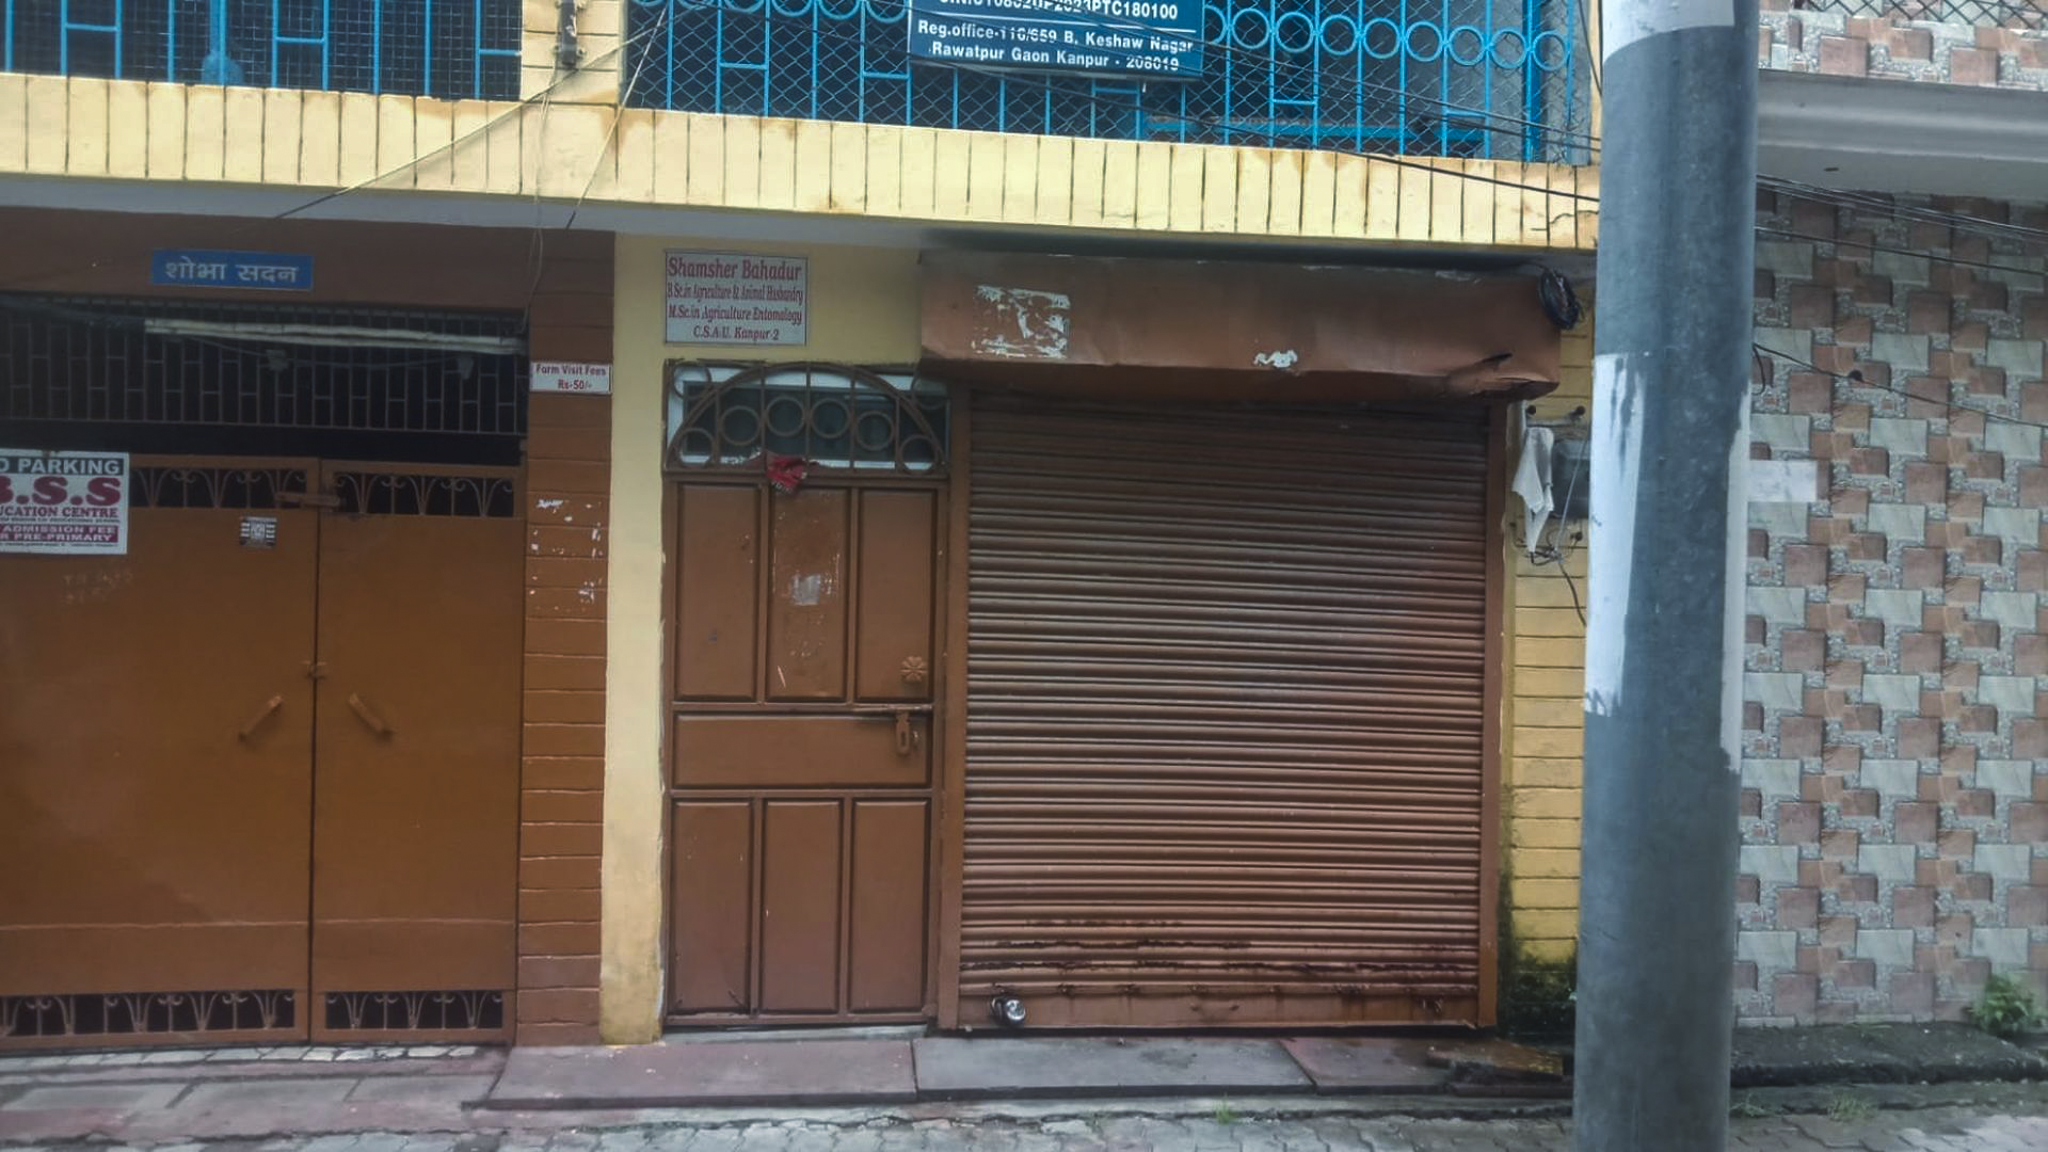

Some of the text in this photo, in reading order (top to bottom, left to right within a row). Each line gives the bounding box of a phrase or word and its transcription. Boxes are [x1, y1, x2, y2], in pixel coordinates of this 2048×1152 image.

[1064, 30, 1078, 45] B.
[1086, 32, 1144, 49] Keshaw
[1150, 36, 1194, 54] Nagar
[932, 41, 1005, 60] Rawatpur
[1011, 47, 1050, 62] Gaon
[1056, 50, 1109, 68] Kanpur
[1126, 55, 1179, 71] 208019
[165, 256, 299, 283] शोभा सदन
[667, 257, 802, 281] Shamsher Bahadur
[702, 305, 750, 322] Agriculture
[752, 307, 802, 326] Entomology
[562, 365, 583, 375] Visit
[18, 458, 120, 475] PARKING
[62, 507, 119, 518] CENTRE
[3, 525, 84, 534] ADMISSION
[14, 533, 112, 542] PRE-PRIMARY
